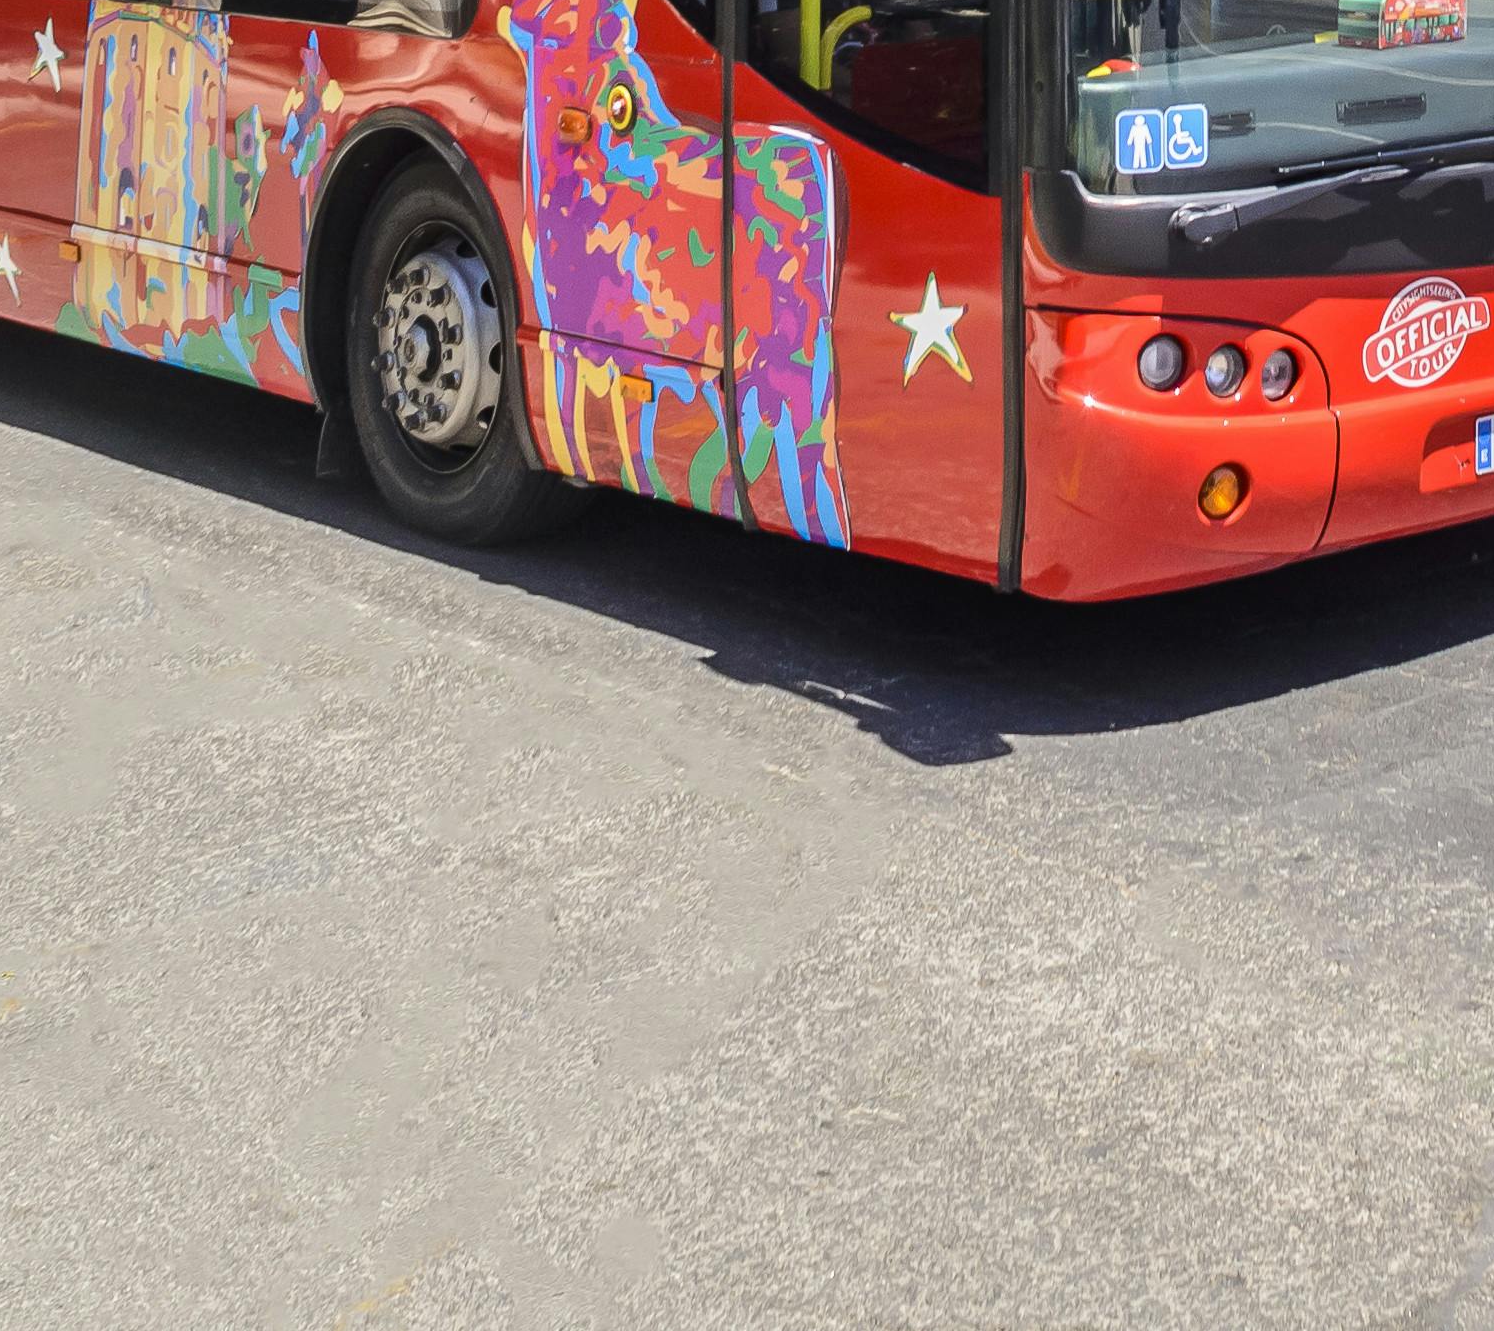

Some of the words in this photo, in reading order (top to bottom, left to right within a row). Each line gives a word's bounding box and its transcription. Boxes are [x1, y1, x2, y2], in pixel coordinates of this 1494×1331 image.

[1392, 283, 1457, 323] CITYSIGHTSEEING
[1376, 302, 1483, 369] OFFICIAL
[1409, 341, 1457, 379] TOUR
